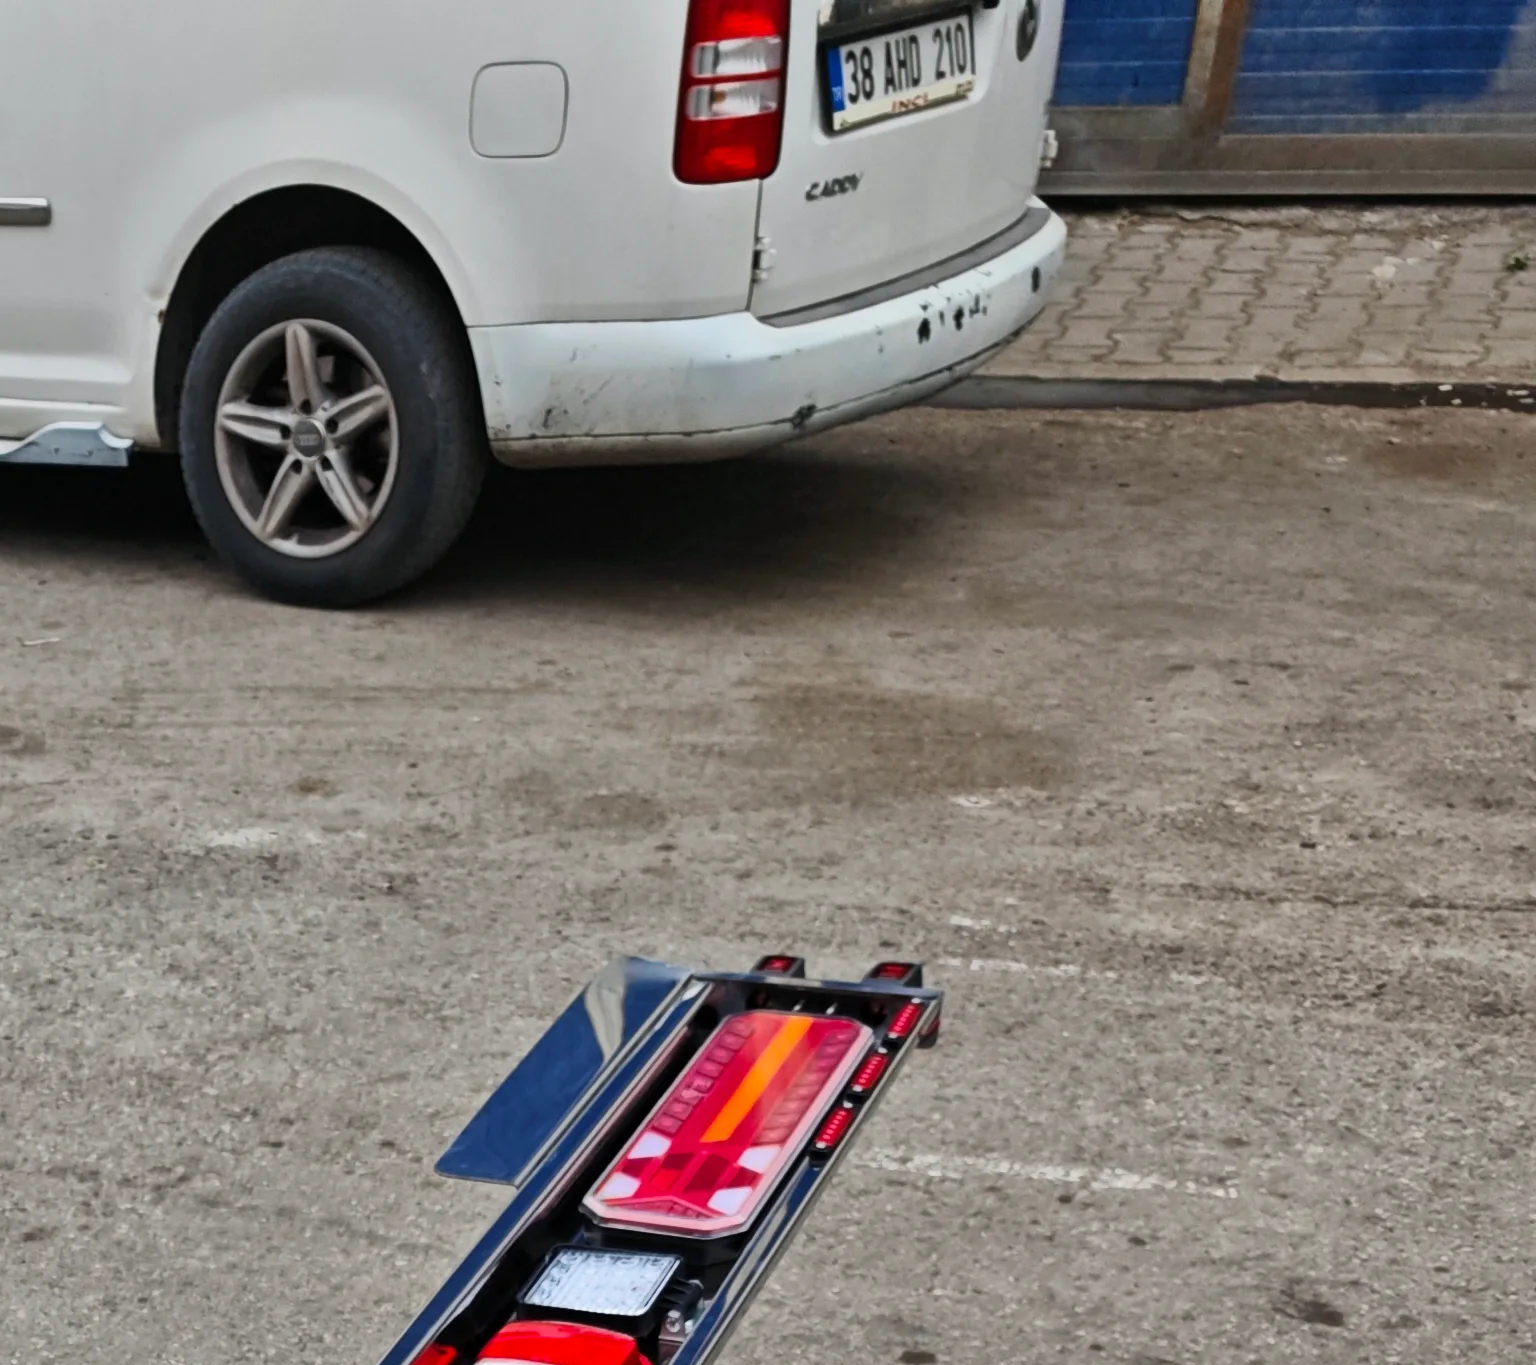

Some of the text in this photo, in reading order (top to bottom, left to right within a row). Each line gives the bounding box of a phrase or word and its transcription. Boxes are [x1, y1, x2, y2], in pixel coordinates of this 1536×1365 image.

[845, 47, 875, 105] 38
[884, 34, 922, 95] AHD
[932, 22, 967, 81] 210
[805, 171, 864, 201] CADDY
